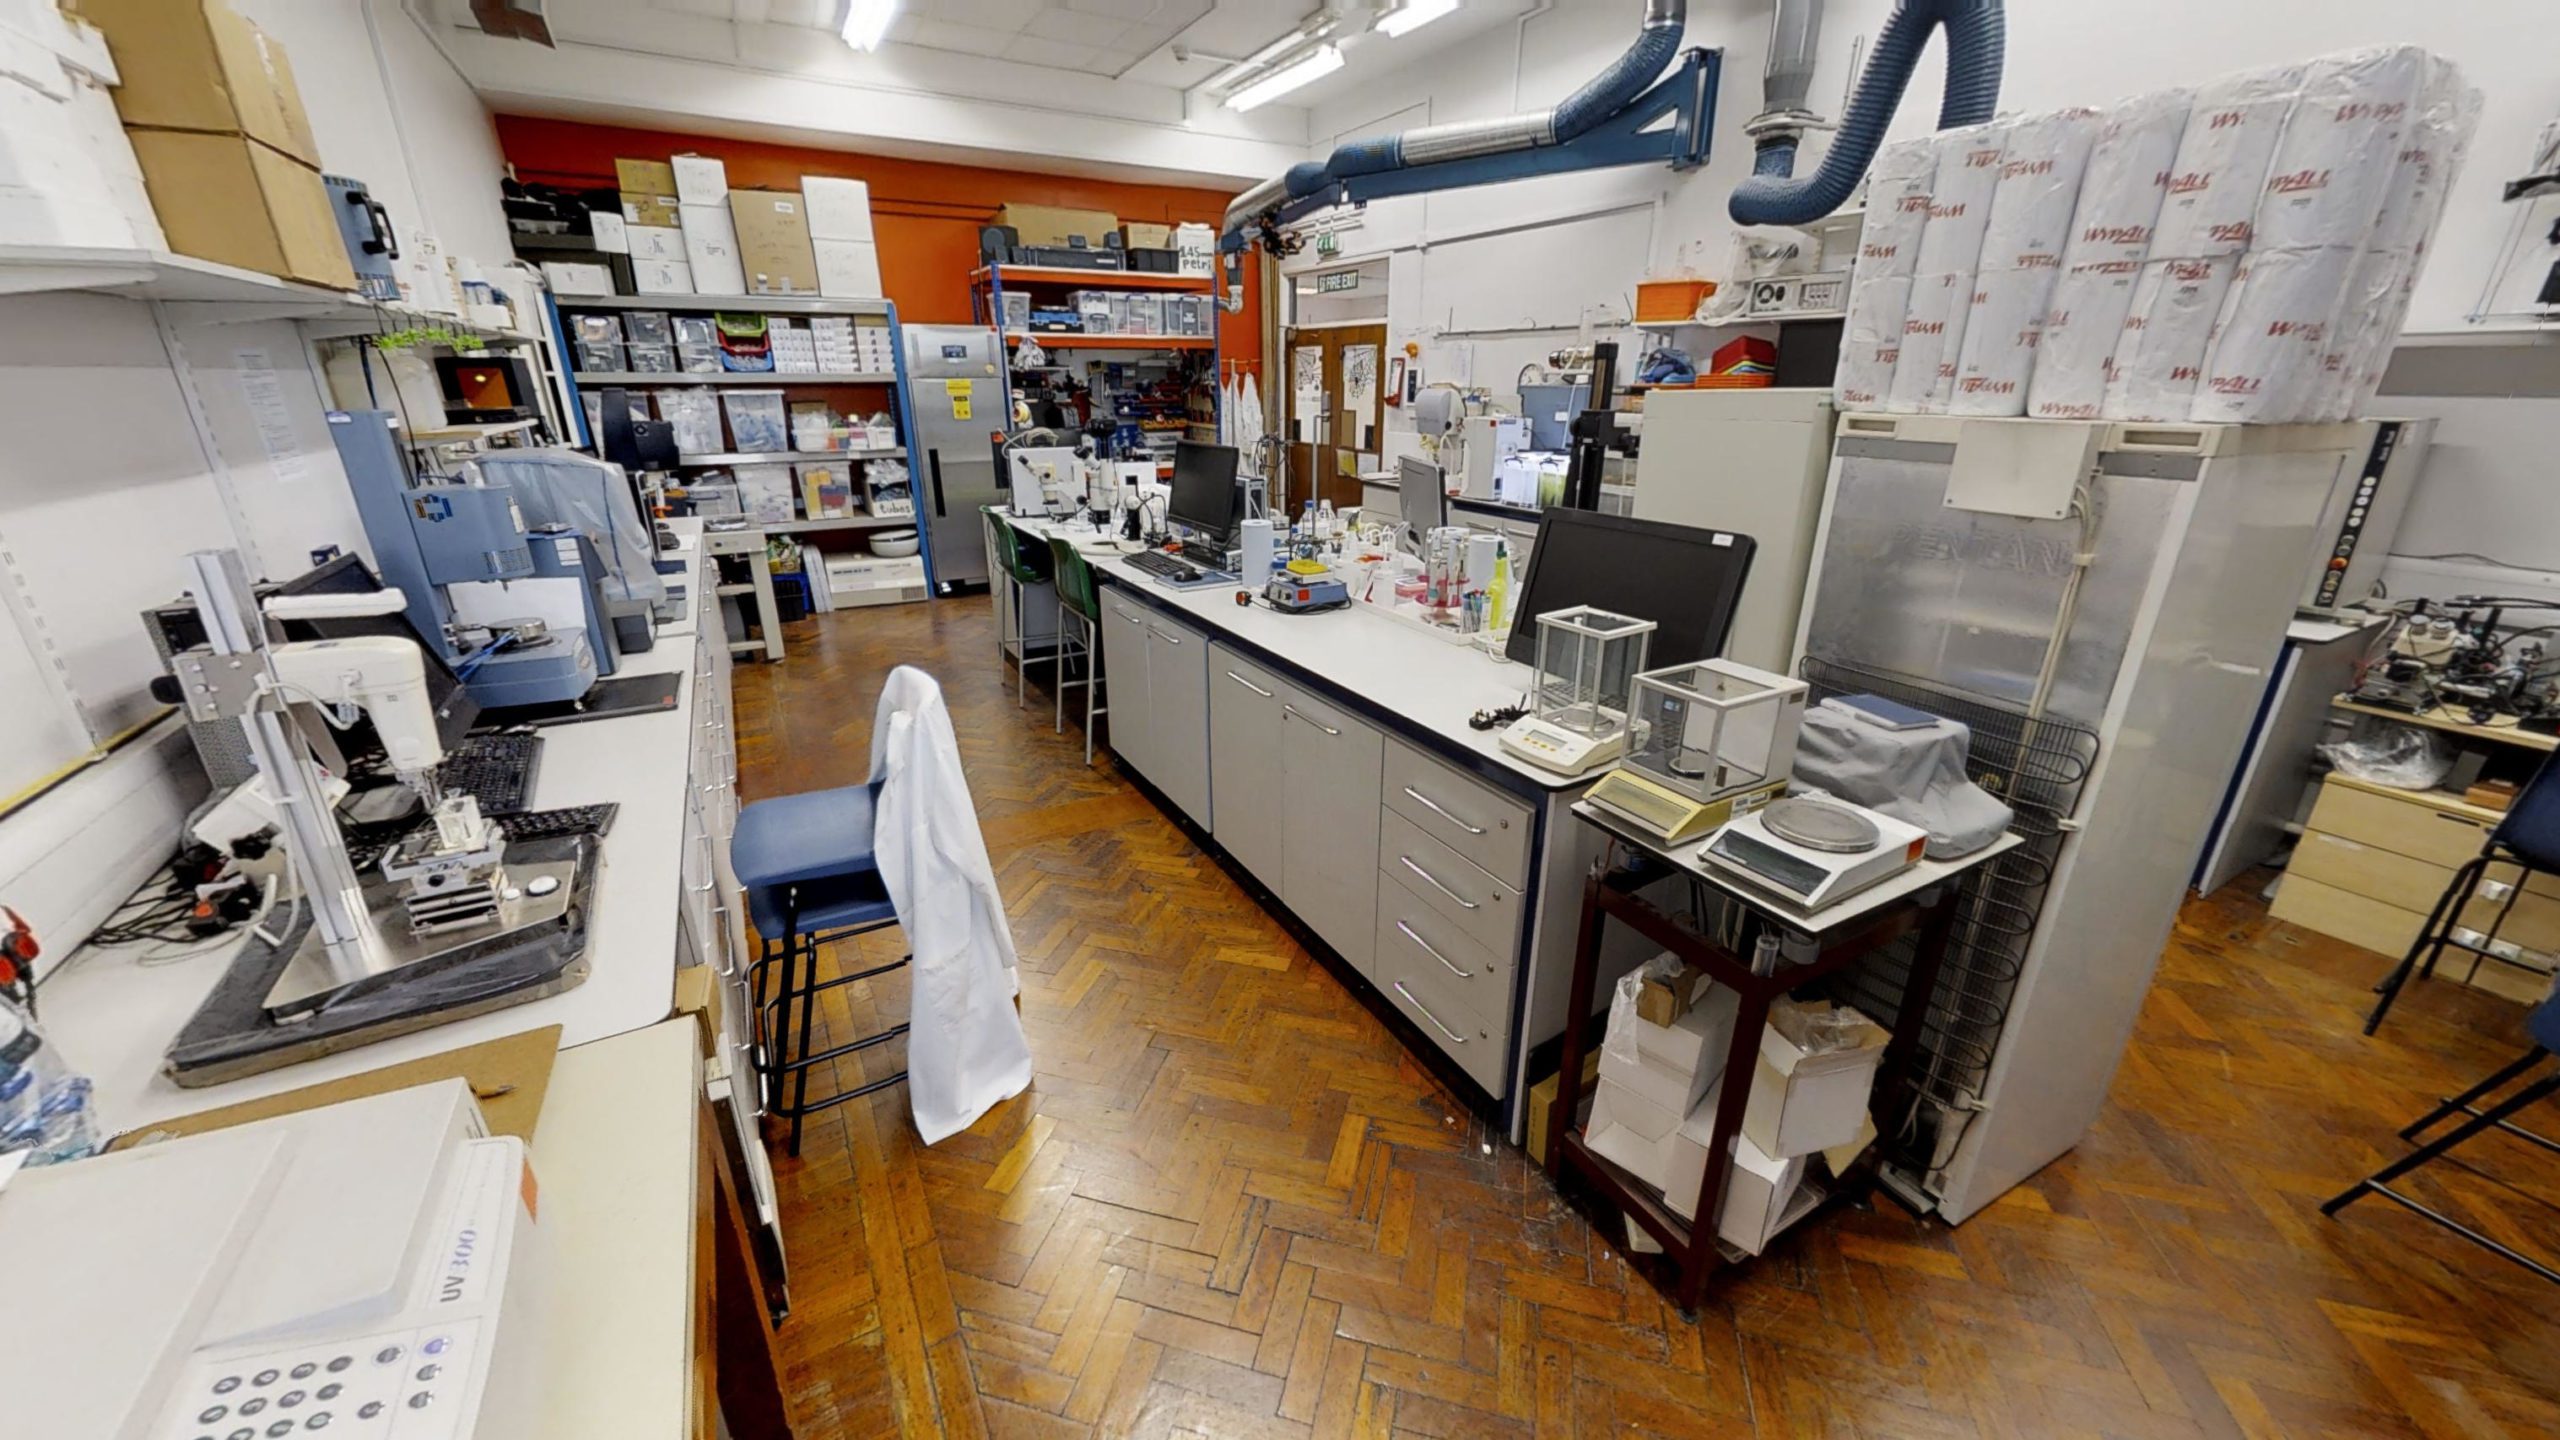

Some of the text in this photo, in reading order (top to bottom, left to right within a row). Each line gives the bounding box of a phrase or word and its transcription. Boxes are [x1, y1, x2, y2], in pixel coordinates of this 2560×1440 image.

[1326, 271, 1357, 290] FIRE EXIT
[440, 1229, 476, 1302] UV 300
